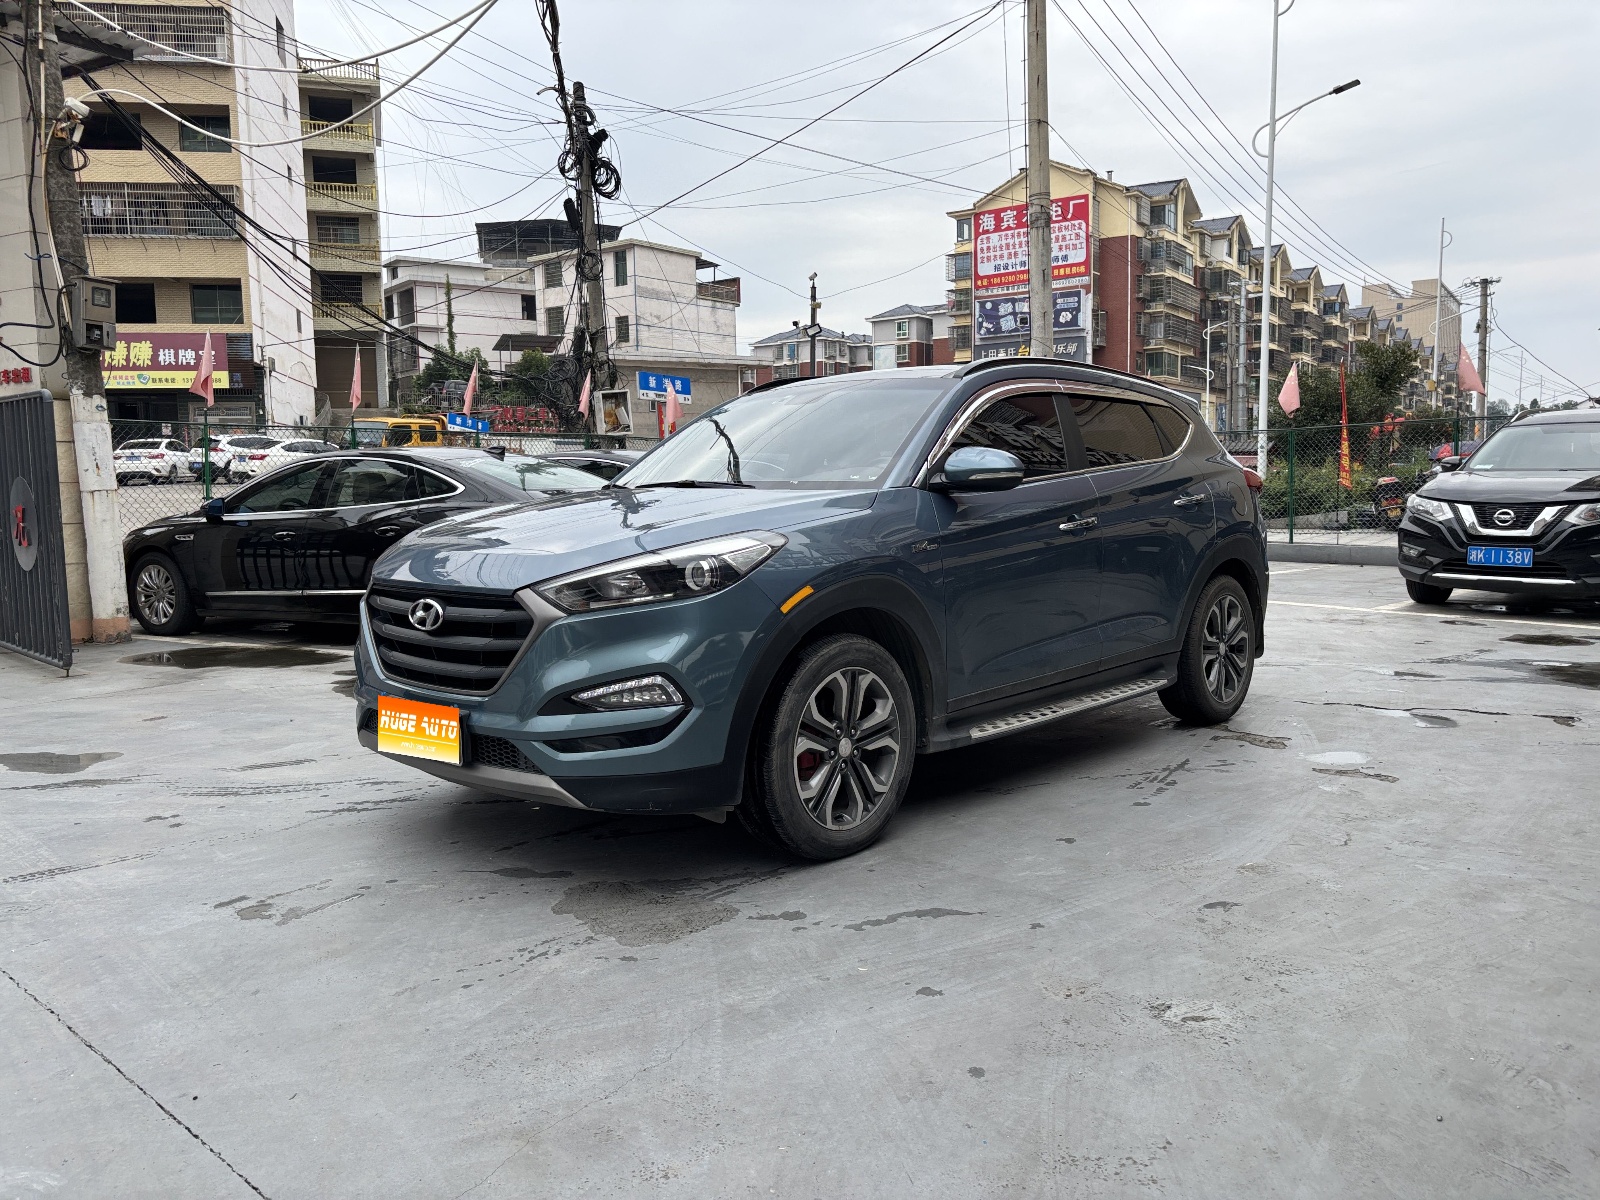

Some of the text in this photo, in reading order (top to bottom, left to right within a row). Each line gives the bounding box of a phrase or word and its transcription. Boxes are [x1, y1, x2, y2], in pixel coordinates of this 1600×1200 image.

[100, 340, 153, 368] 赚赚
[0, 367, 32, 384] 车出租
